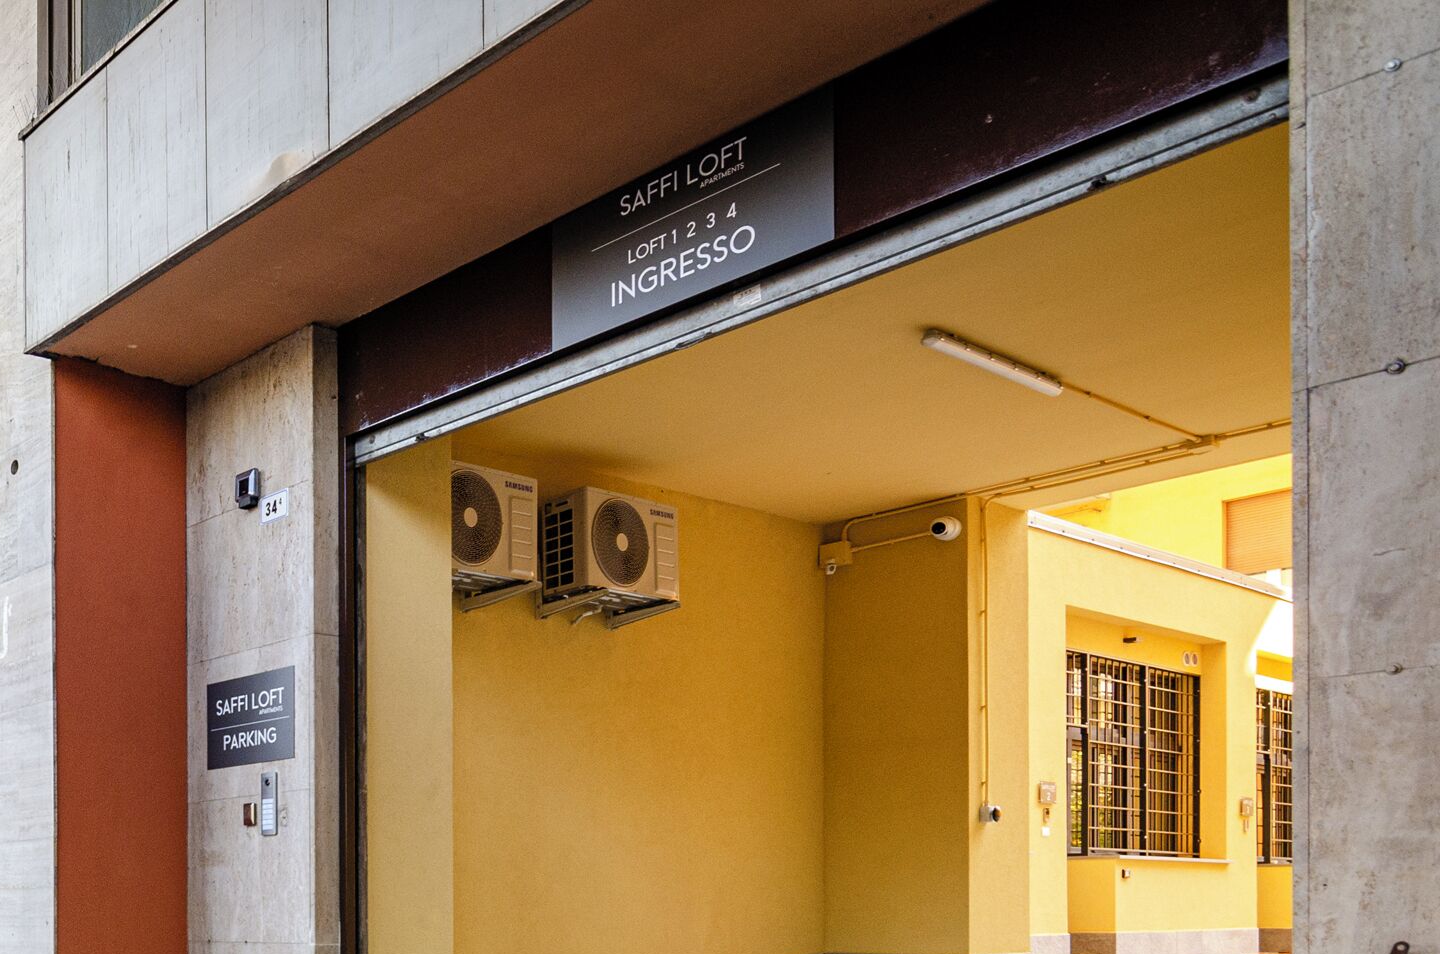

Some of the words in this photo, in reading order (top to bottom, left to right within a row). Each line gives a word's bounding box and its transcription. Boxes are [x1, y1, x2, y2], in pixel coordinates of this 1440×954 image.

[620, 170, 678, 216] SAFFI
[686, 136, 747, 185] LOFT
[699, 162, 745, 189] APARTMENTS
[628, 233, 667, 264] LOFT
[671, 229, 677, 244] 1
[686, 221, 696, 238] 2
[706, 212, 716, 229] 3
[726, 202, 737, 218] 4
[611, 225, 756, 307] INGRESSO
[504, 480, 533, 493] SAMSUNG
[265, 499, 278, 517] 34
[649, 508, 674, 520] SAMSUNG
[215, 694, 248, 716] SAFFI
[251, 686, 285, 710] LOFT
[223, 727, 277, 751] PARKING
